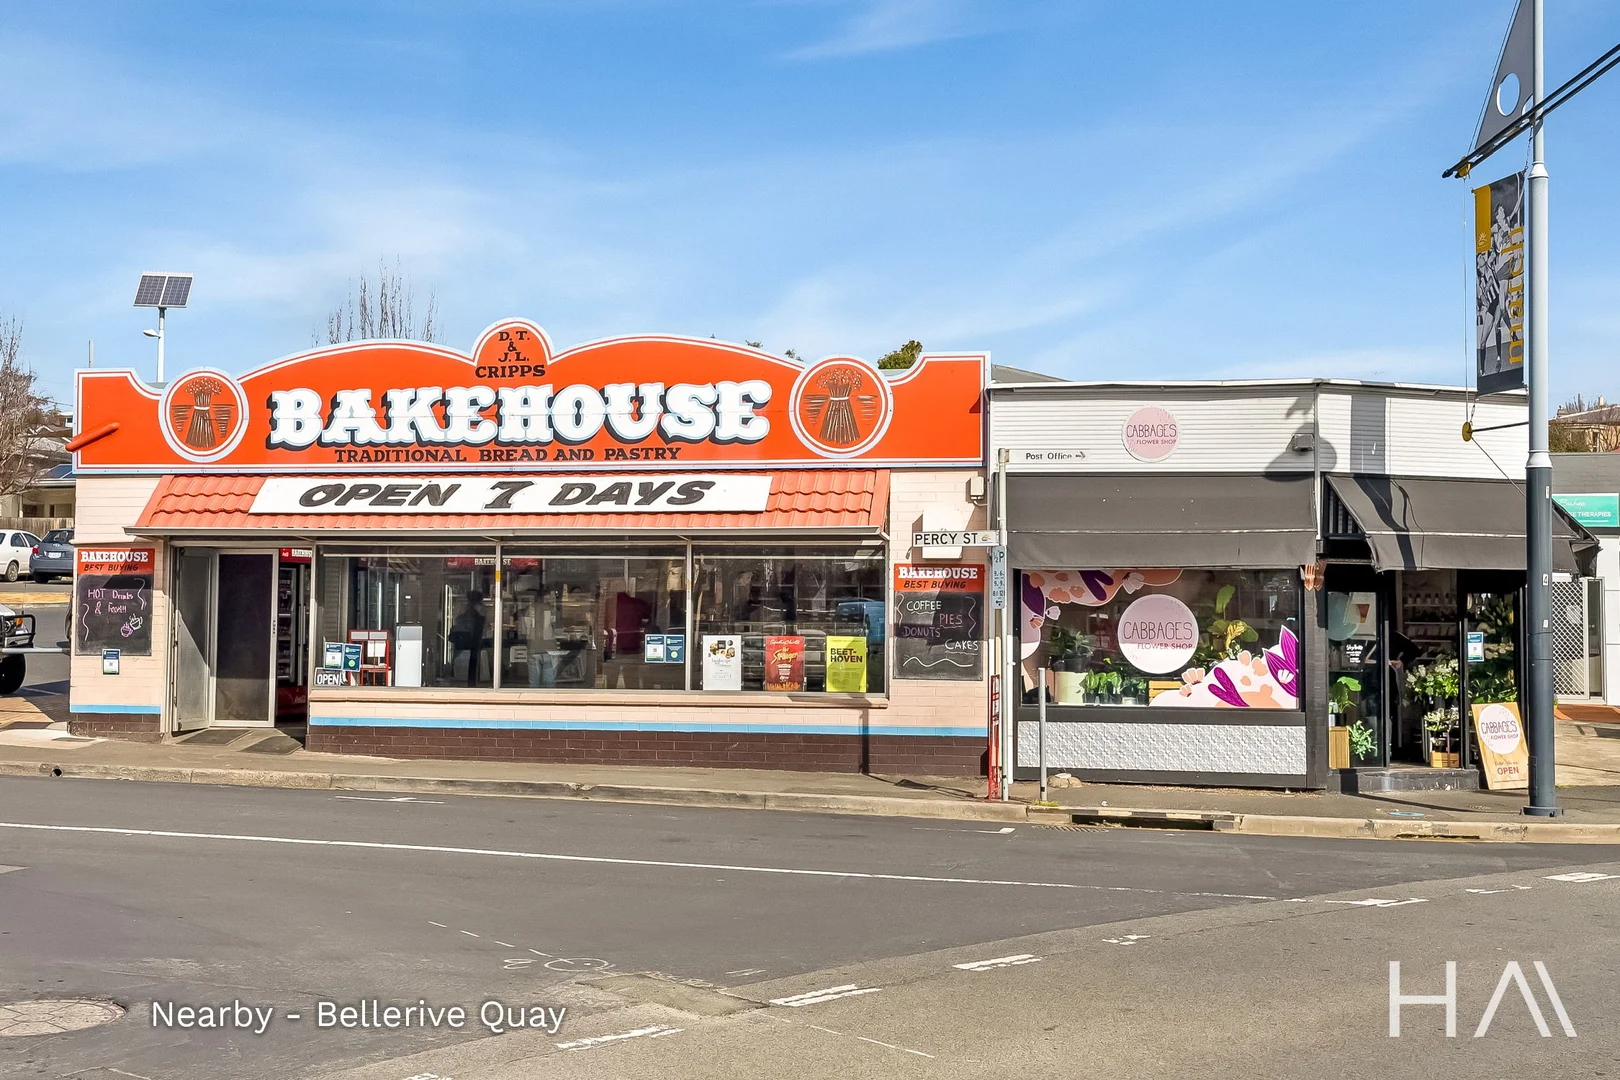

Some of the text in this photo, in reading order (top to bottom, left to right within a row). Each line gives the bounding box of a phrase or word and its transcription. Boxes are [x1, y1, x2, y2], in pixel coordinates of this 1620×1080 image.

[507, 341, 518, 352] &
[475, 364, 546, 378] CRIPPS
[266, 380, 773, 451] BAKEHOUSE
[1126, 423, 1177, 438] CABBAGES
[335, 447, 682, 463] TRADITIONAL BREAD AND PASTRY
[1025, 452, 1073, 460] Post Office
[298, 480, 716, 511] OPEN 7 DAYS
[915, 532, 978, 545] PERCY ST
[80, 551, 149, 563] BAKEHOUSE
[84, 563, 139, 572] BEST BUYING
[898, 566, 978, 579] BAKEHOUSE
[903, 580, 966, 589] BEST BUYING
[88, 588, 106, 600] HOT
[906, 600, 942, 612] COFFEE
[939, 613, 963, 625] PIES
[904, 626, 941, 638] DONUTS
[1123, 621, 1193, 640] CABBAGES
[944, 638, 979, 651] CAKES
[1137, 642, 1193, 650] FLOWER SHOP
[830, 655, 863, 663] HOVEN
[316, 673, 340, 685] OPEN
[1480, 720, 1518, 735] CABBAGES
[1496, 766, 1520, 775] OPEN
